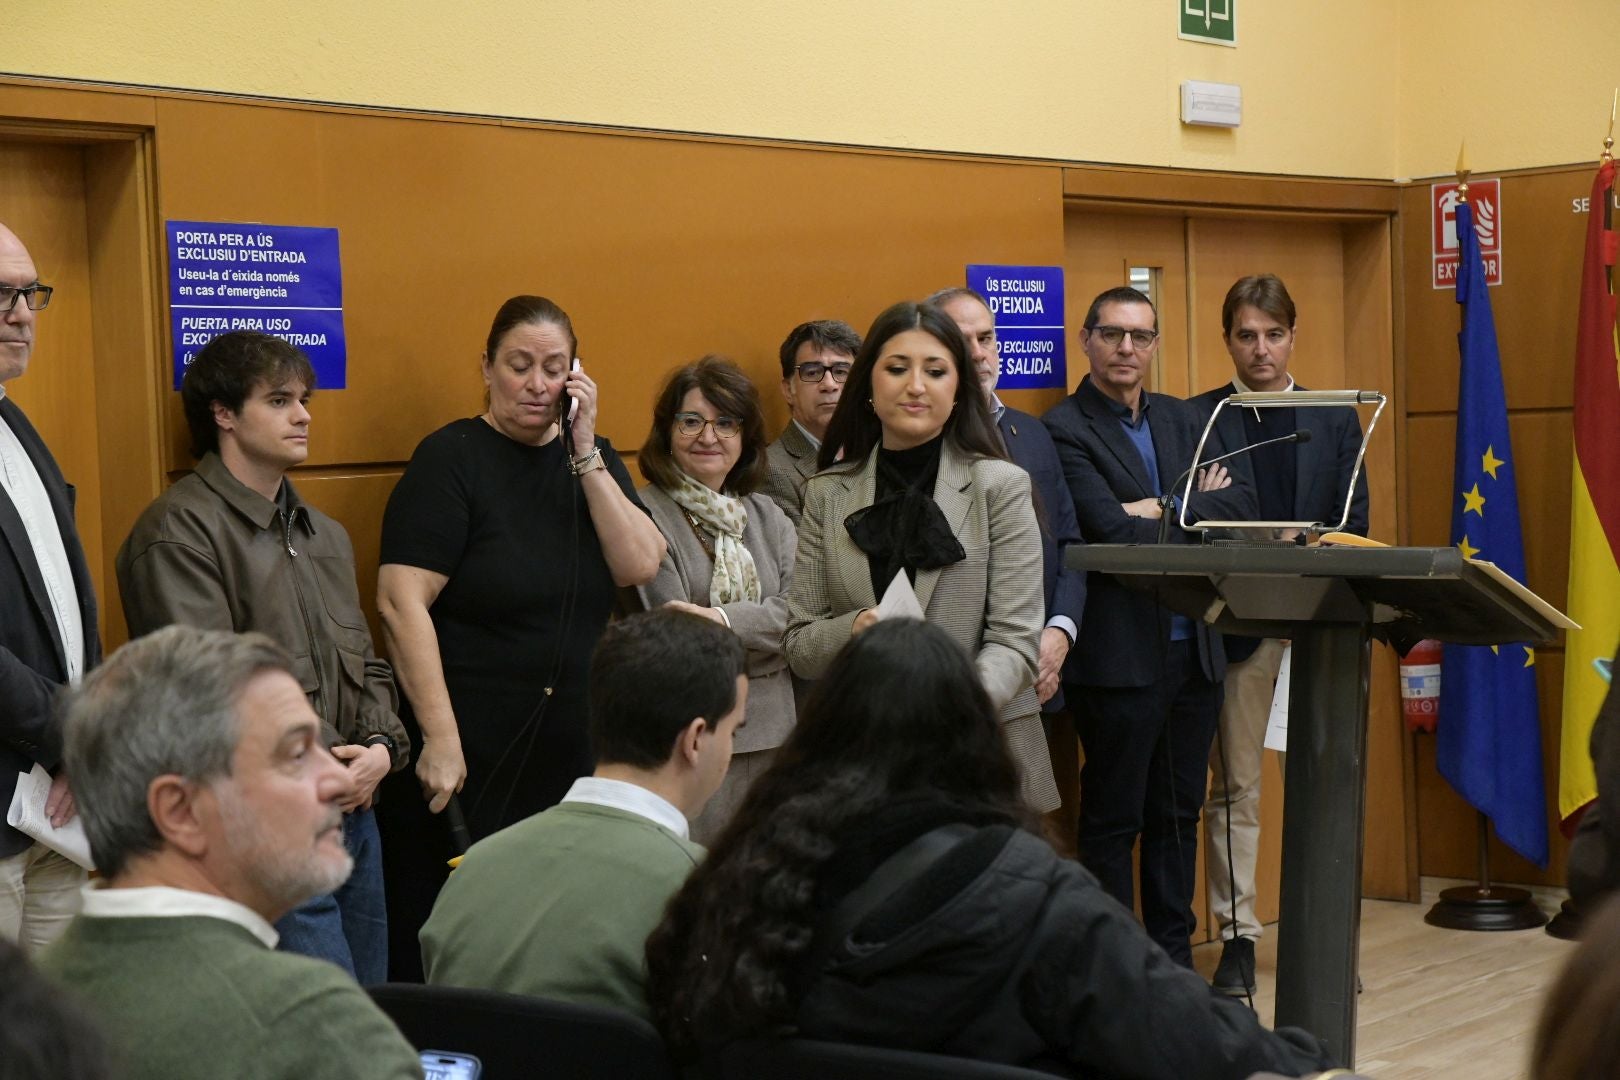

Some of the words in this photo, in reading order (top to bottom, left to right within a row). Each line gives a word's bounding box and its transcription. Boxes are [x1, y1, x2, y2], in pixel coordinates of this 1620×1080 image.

[176, 232, 217, 245] PORTA
[219, 233, 244, 246] PER
[246, 235, 255, 247] A
[257, 233, 273, 247] ÚS
[177, 248, 236, 261] EXCLUSIU
[178, 268, 219, 280] Useu-la
[265, 271, 300, 283] només
[179, 287, 193, 295] en
[195, 287, 214, 296] cas
[986, 277, 999, 292] ÚS
[1001, 280, 1045, 293] EXCLUSIU
[181, 317, 229, 330] PUERTA
[231, 318, 264, 330] PARA
[266, 319, 291, 331] USO
[1003, 340, 1054, 354] EXCLUSIVO
[1006, 357, 1052, 375] SALIDA
